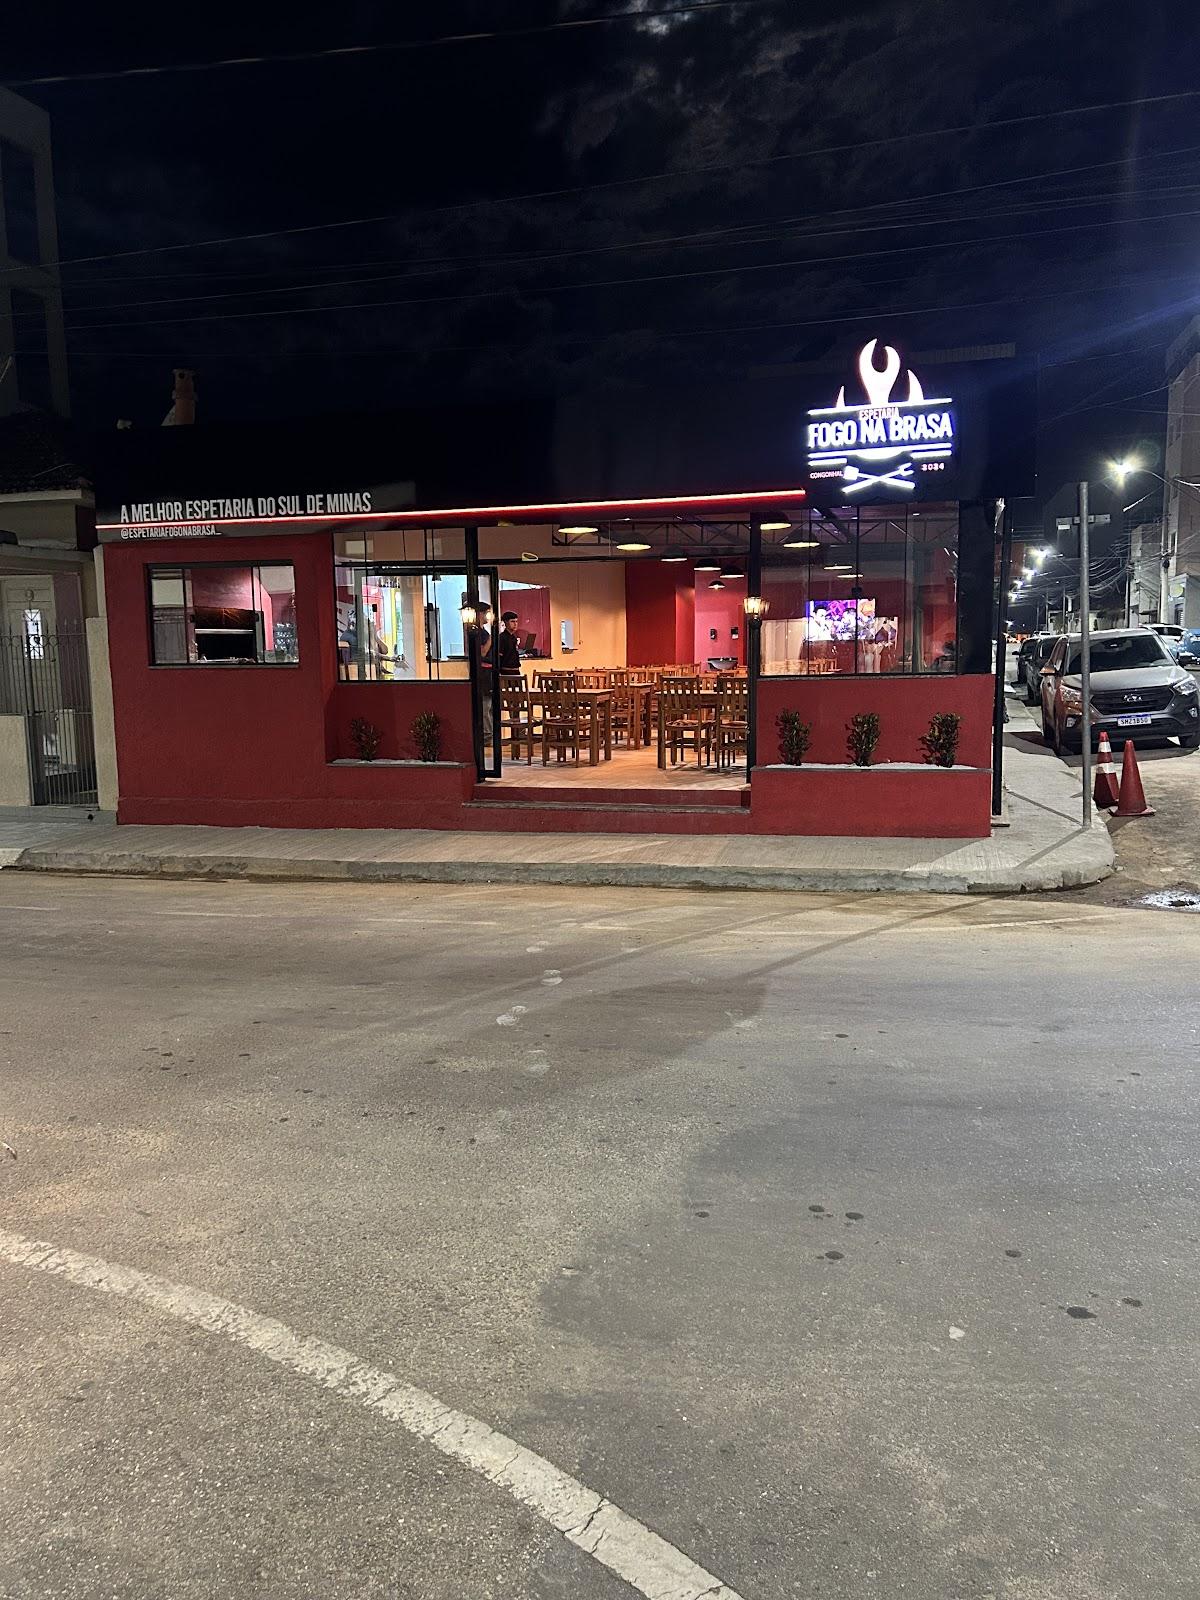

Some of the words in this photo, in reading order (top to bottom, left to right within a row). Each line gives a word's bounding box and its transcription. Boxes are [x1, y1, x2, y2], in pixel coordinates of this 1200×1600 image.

[859, 407, 900, 420] ESPETARIA
[808, 420, 857, 449] FOGO
[860, 418, 887, 444] NA
[889, 412, 954, 442] BRASA
[120, 505, 130, 523] A
[132, 502, 183, 522] MELHOR
[186, 498, 255, 519] ESPETARIA
[258, 497, 276, 517] DO
[278, 495, 304, 515] SUL
[306, 494, 324, 514] DE
[327, 492, 372, 513] MINAS
